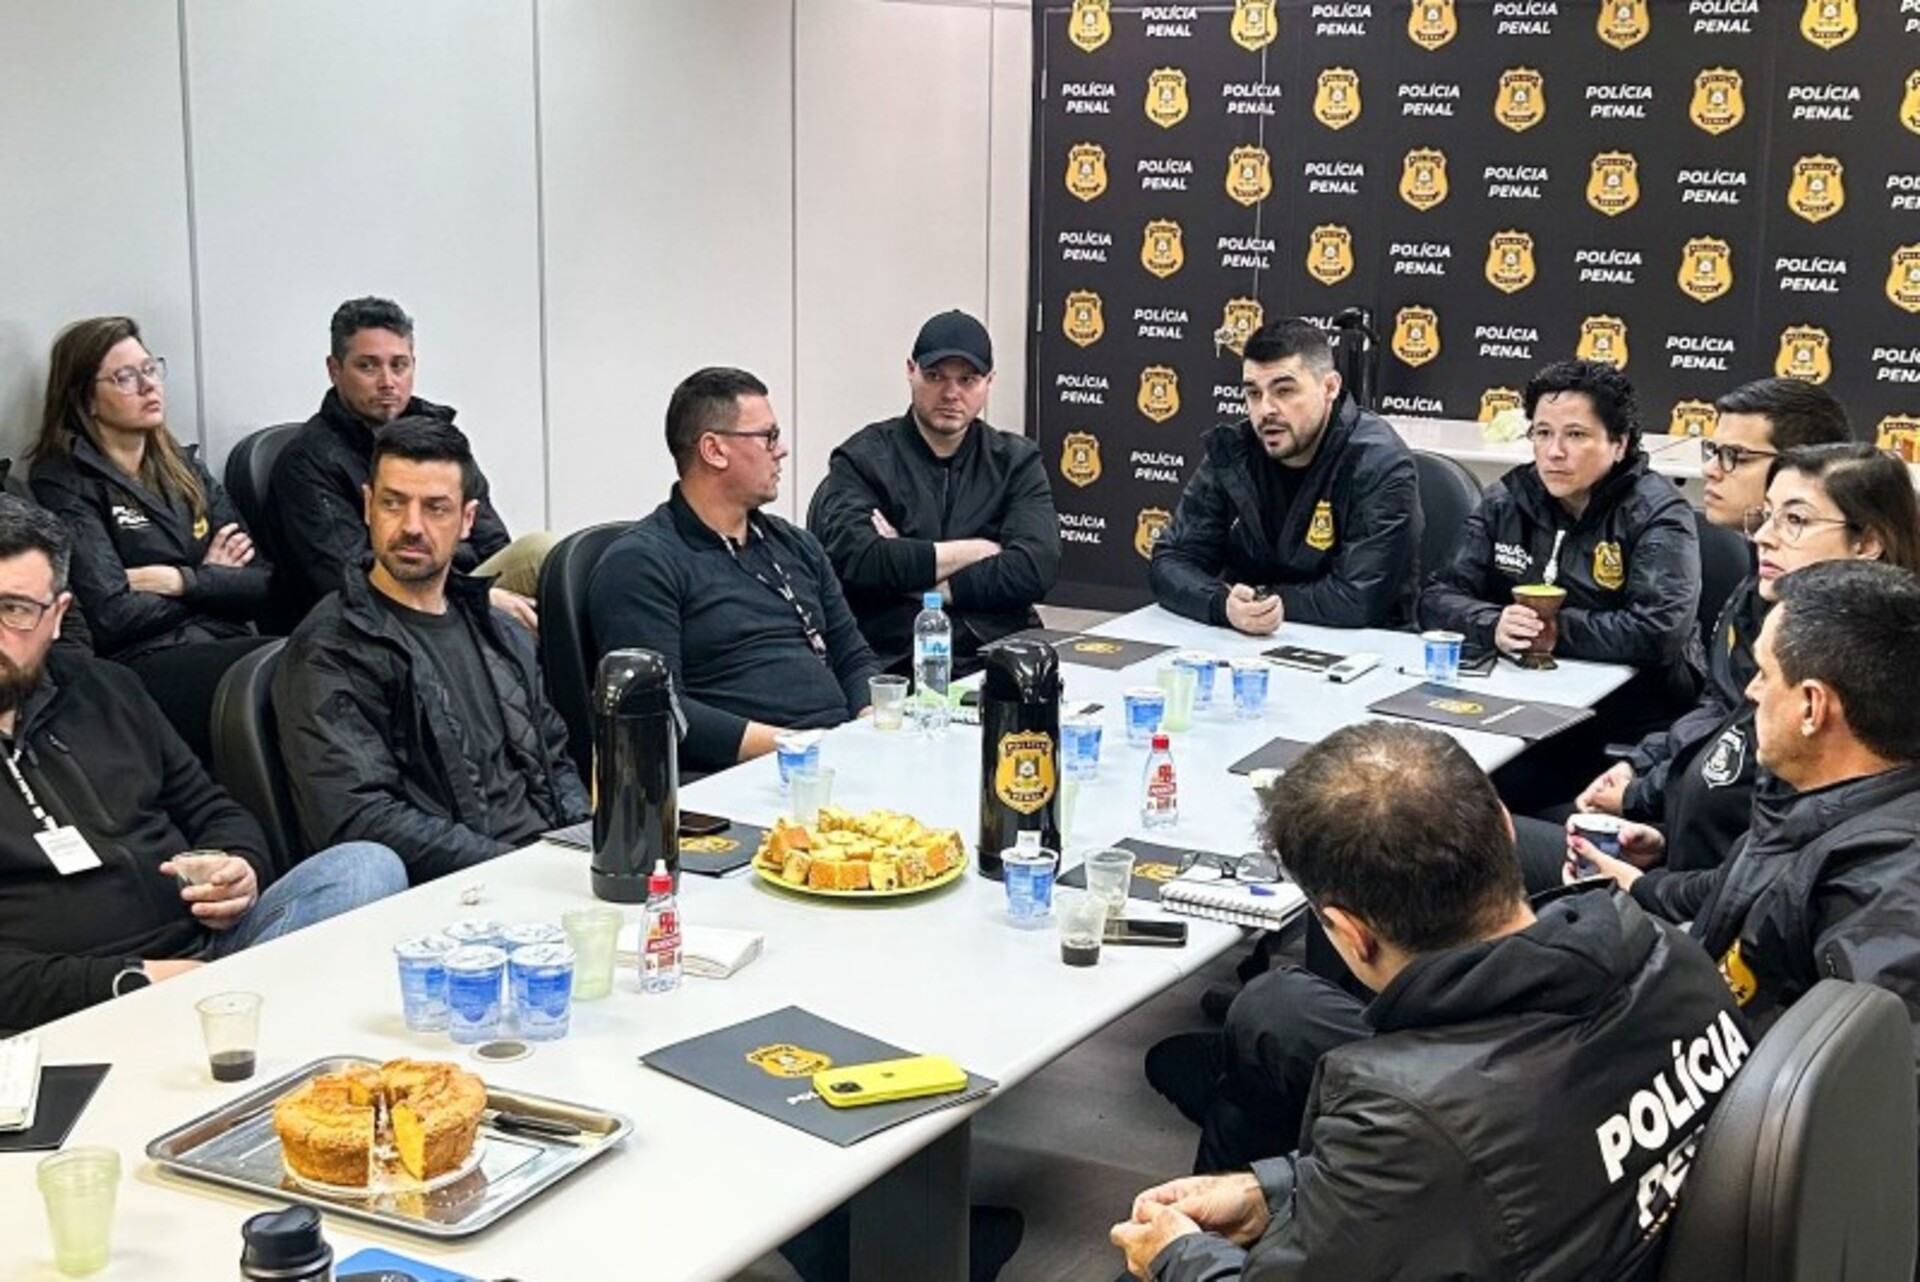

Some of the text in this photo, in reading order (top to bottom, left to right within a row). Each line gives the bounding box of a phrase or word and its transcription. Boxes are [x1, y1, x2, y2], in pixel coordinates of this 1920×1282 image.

[1142, 5, 1197, 20] POLÍCIA
[1311, 2, 1371, 17] POLÍCIA
[1493, 0, 1558, 15] POLÍCIA
[1146, 24, 1192, 37] PENAL
[1316, 23, 1366, 35] PENAL
[1498, 21, 1550, 34] PENAL
[1694, 19, 1751, 32] PENAL
[1062, 81, 1115, 96] POLÍCIA
[1223, 82, 1281, 97] POLÍCIA
[1398, 83, 1460, 98] POLÍCIA
[1586, 83, 1652, 99] POLÍCIA
[1788, 83, 1860, 101] POLÍCIA
[1066, 101, 1110, 113] PENAL
[1227, 102, 1275, 115] PENAL
[1403, 103, 1453, 116] PENAL
[1591, 105, 1645, 118] PENAL
[1793, 106, 1852, 120] PENAL
[1138, 158, 1192, 173] POLÍCIA
[1305, 161, 1364, 176] POLÍCIA
[1484, 165, 1548, 180] POLÍCIA
[1142, 177, 1186, 190] PENAL
[1678, 169, 1746, 185] POLÍCIA
[1309, 180, 1358, 194] PENAL
[1488, 185, 1541, 198] PENAL
[1682, 190, 1739, 204] PENAL
[1059, 230, 1112, 245] POLÍCIA
[1218, 236, 1275, 252] POLÍCIA
[1063, 249, 1106, 261] PENAL
[1390, 242, 1451, 257] POLÍCIA
[1575, 249, 1642, 264] POLÍCIA
[1222, 255, 1269, 268] PENAL
[1394, 261, 1445, 275] PENAL
[1775, 256, 1846, 273] POLÍCIA
[1580, 269, 1634, 283] PENAL
[1780, 277, 1839, 292] PENAL
[1134, 307, 1188, 324] POLÍCIA
[1138, 325, 1182, 339] PENAL
[1475, 325, 1538, 341] POLÍCIA
[1480, 344, 1531, 358] PENAL
[1666, 335, 1734, 352] POLÍCIA
[1671, 355, 1727, 370] PENAL
[1872, 347, 1920, 363] POLÍ
[1056, 374, 1108, 389] POLÍCIA
[1061, 391, 1104, 404] PENAL
[1382, 395, 1443, 412] POLÍCIA
[1217, 403, 1247, 414] PEN
[1131, 451, 1183, 467] POLÍCIA
[1135, 468, 1178, 482] PENAL
[1596, 1010, 1750, 1183] POLÍCIA
